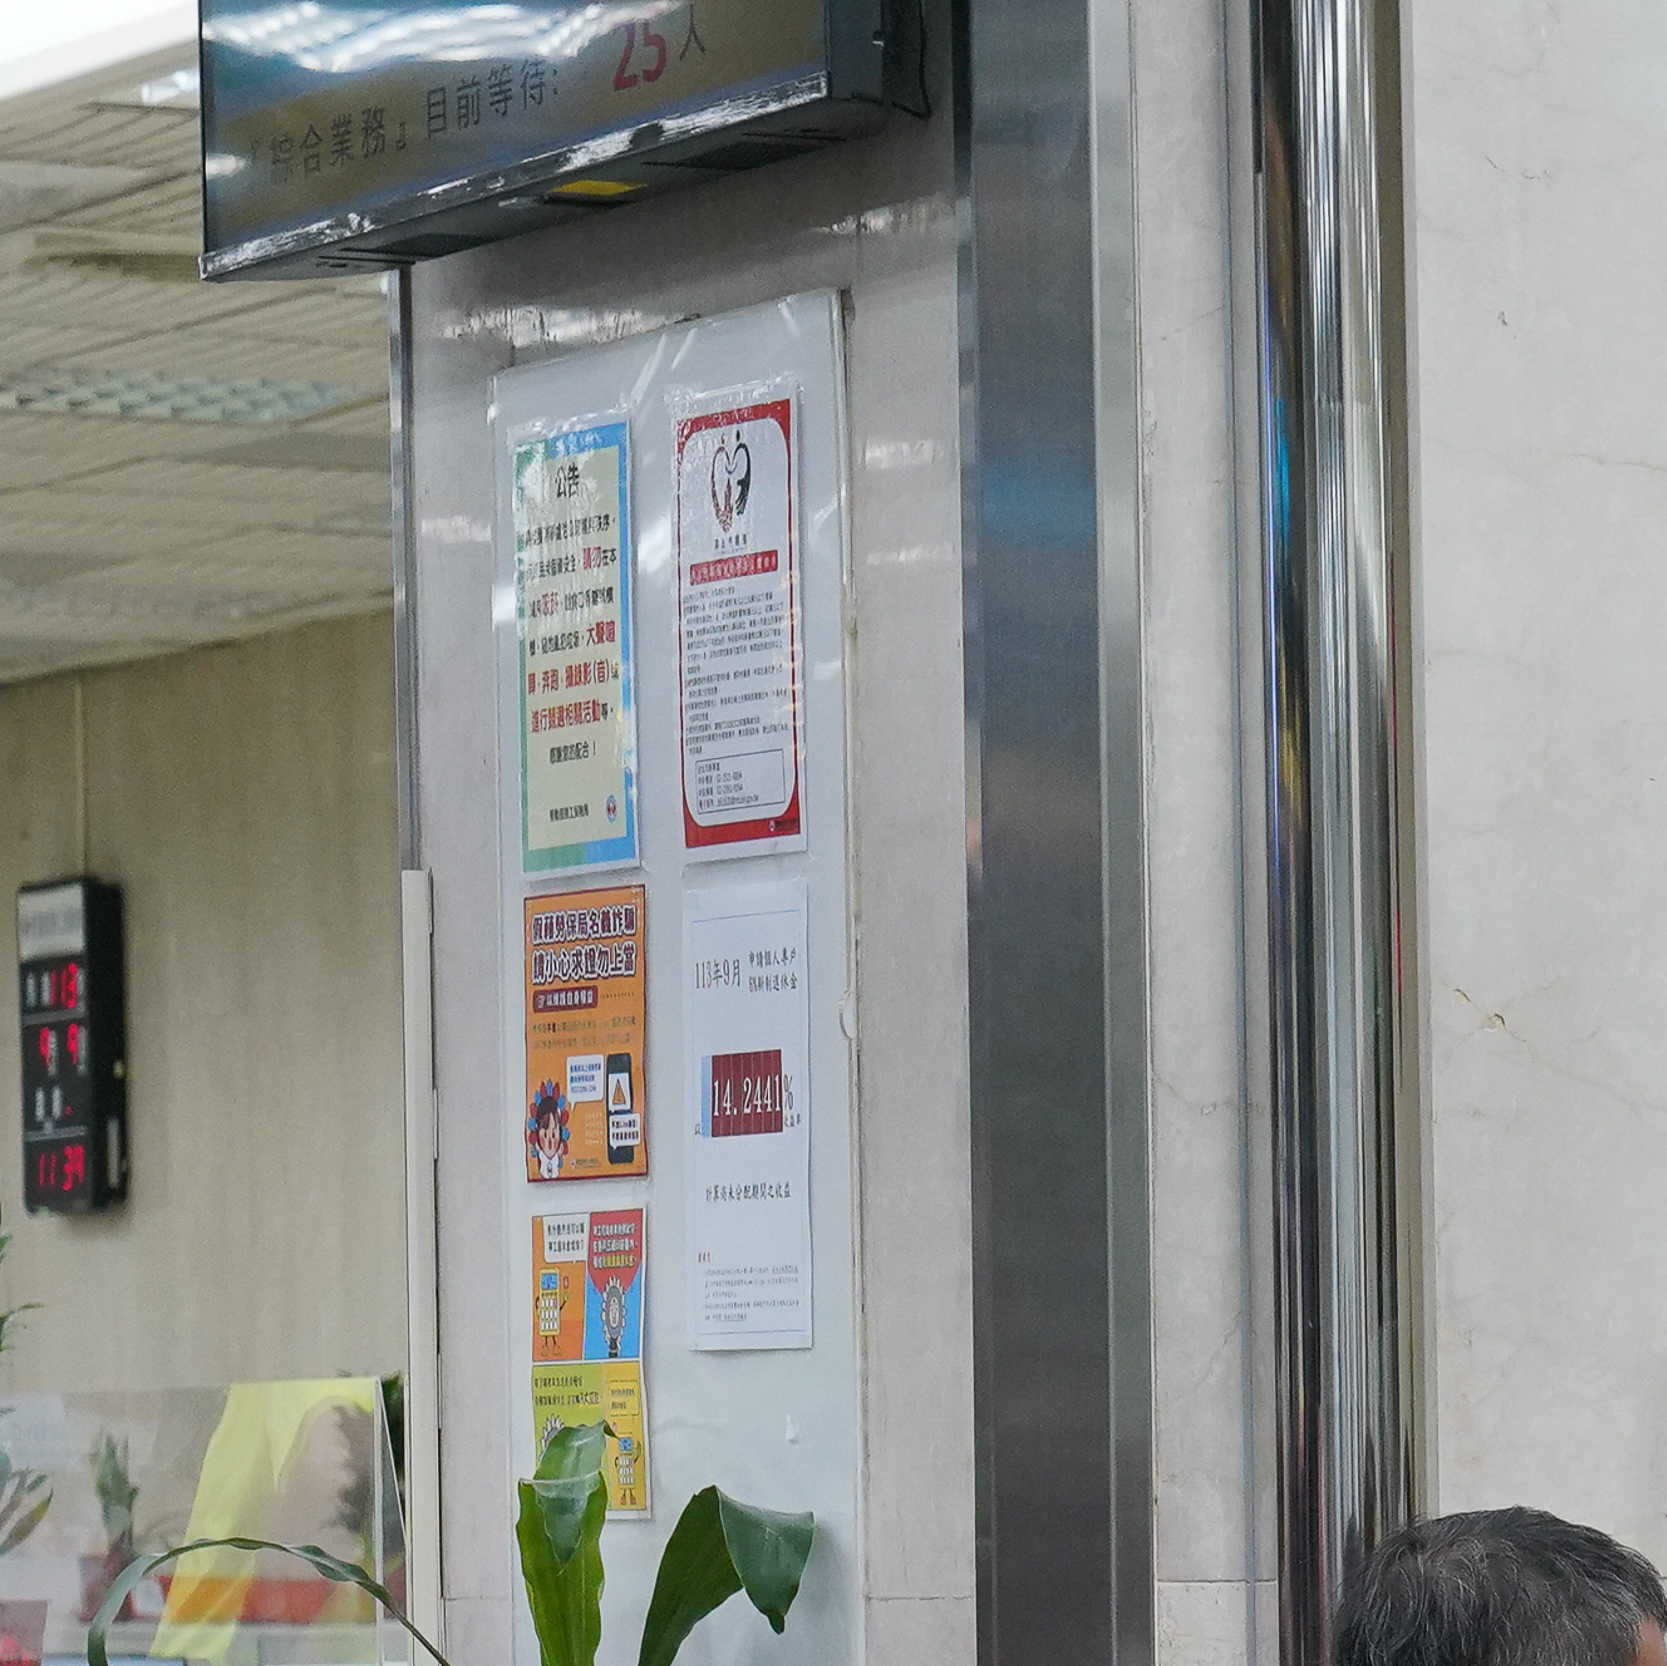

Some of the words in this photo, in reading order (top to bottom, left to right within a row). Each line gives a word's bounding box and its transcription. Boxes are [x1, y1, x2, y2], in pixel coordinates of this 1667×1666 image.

[679, 4, 706, 61] 人
[556, 461, 580, 498] 公告
[532, 940, 637, 985] 請小心求證勿上當
[695, 958, 741, 989] 113年9月
[713, 1073, 794, 1117] 14.2441%
